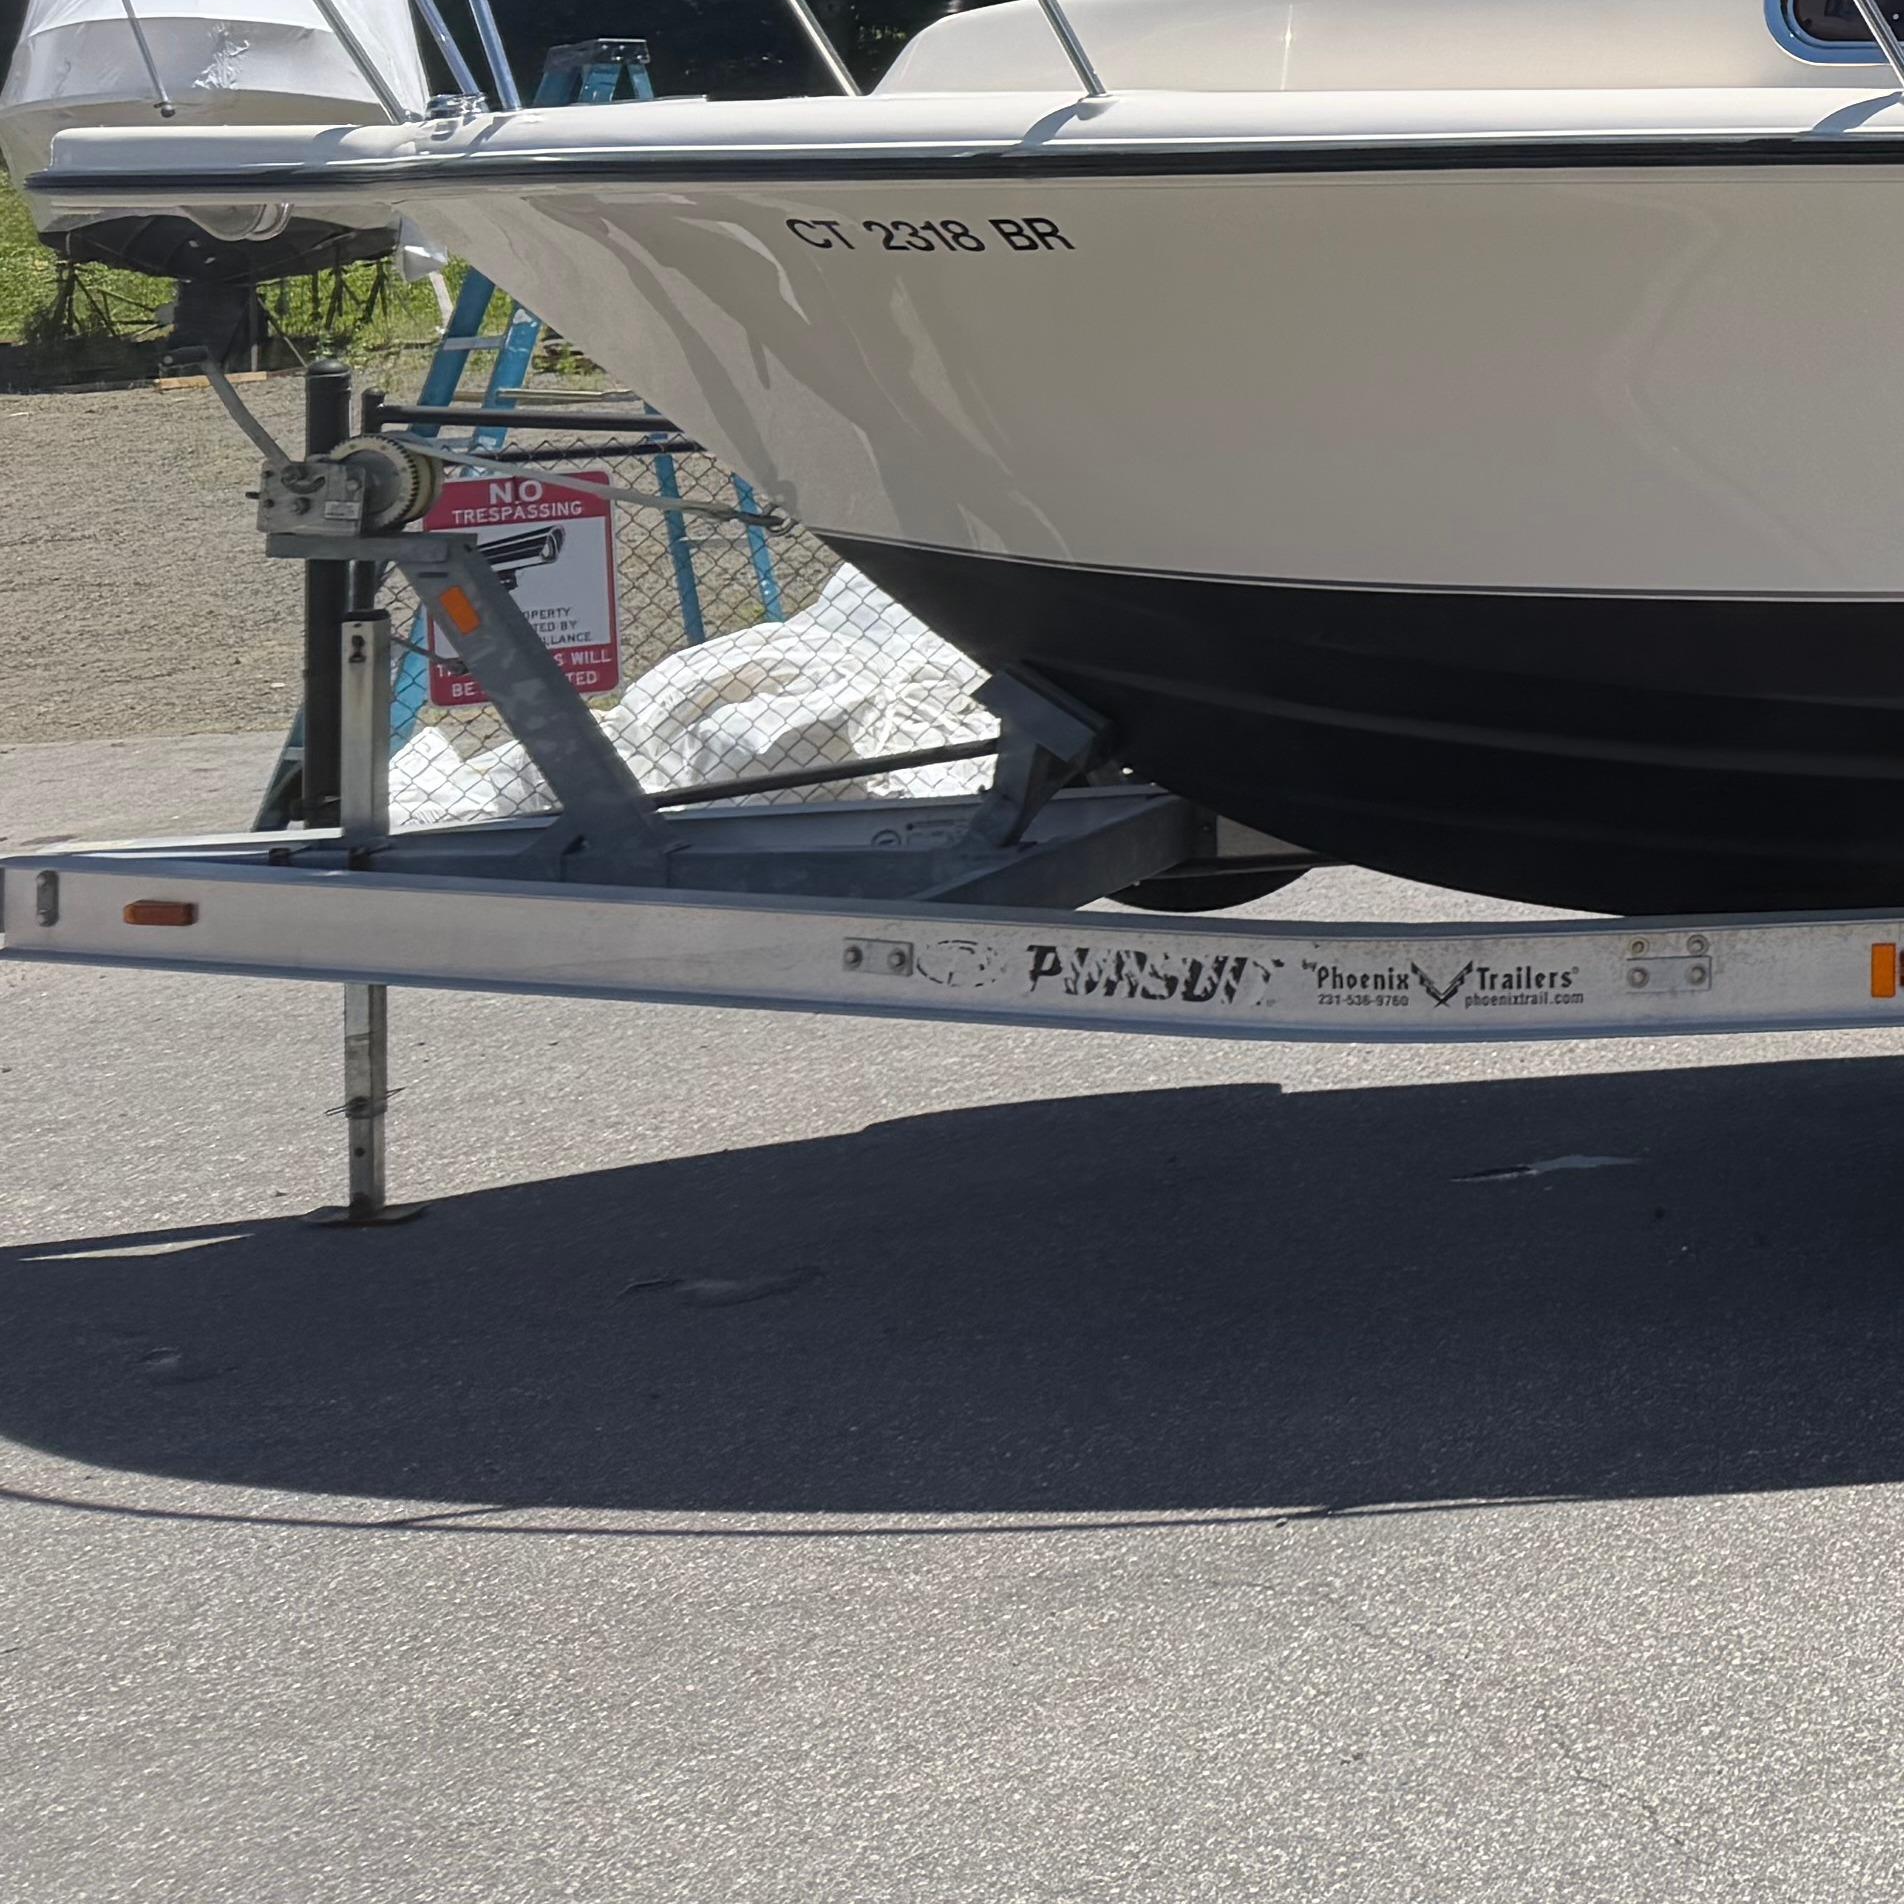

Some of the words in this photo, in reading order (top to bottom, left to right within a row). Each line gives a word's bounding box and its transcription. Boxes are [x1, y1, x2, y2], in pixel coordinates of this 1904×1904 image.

[785, 218, 856, 250] CT
[863, 219, 986, 252] 2318
[987, 217, 1077, 251] BR
[489, 480, 543, 504] NO
[452, 500, 583, 525] TRESPASSING
[521, 607, 571, 620] OPERTY
[560, 620, 578, 631] BY
[571, 649, 612, 666] WILL
[452, 681, 475, 698] BE
[1317, 965, 1409, 991] Phoenix
[1476, 965, 1573, 991] Trailers
[1464, 991, 1584, 1010] phoenixtrail.com
